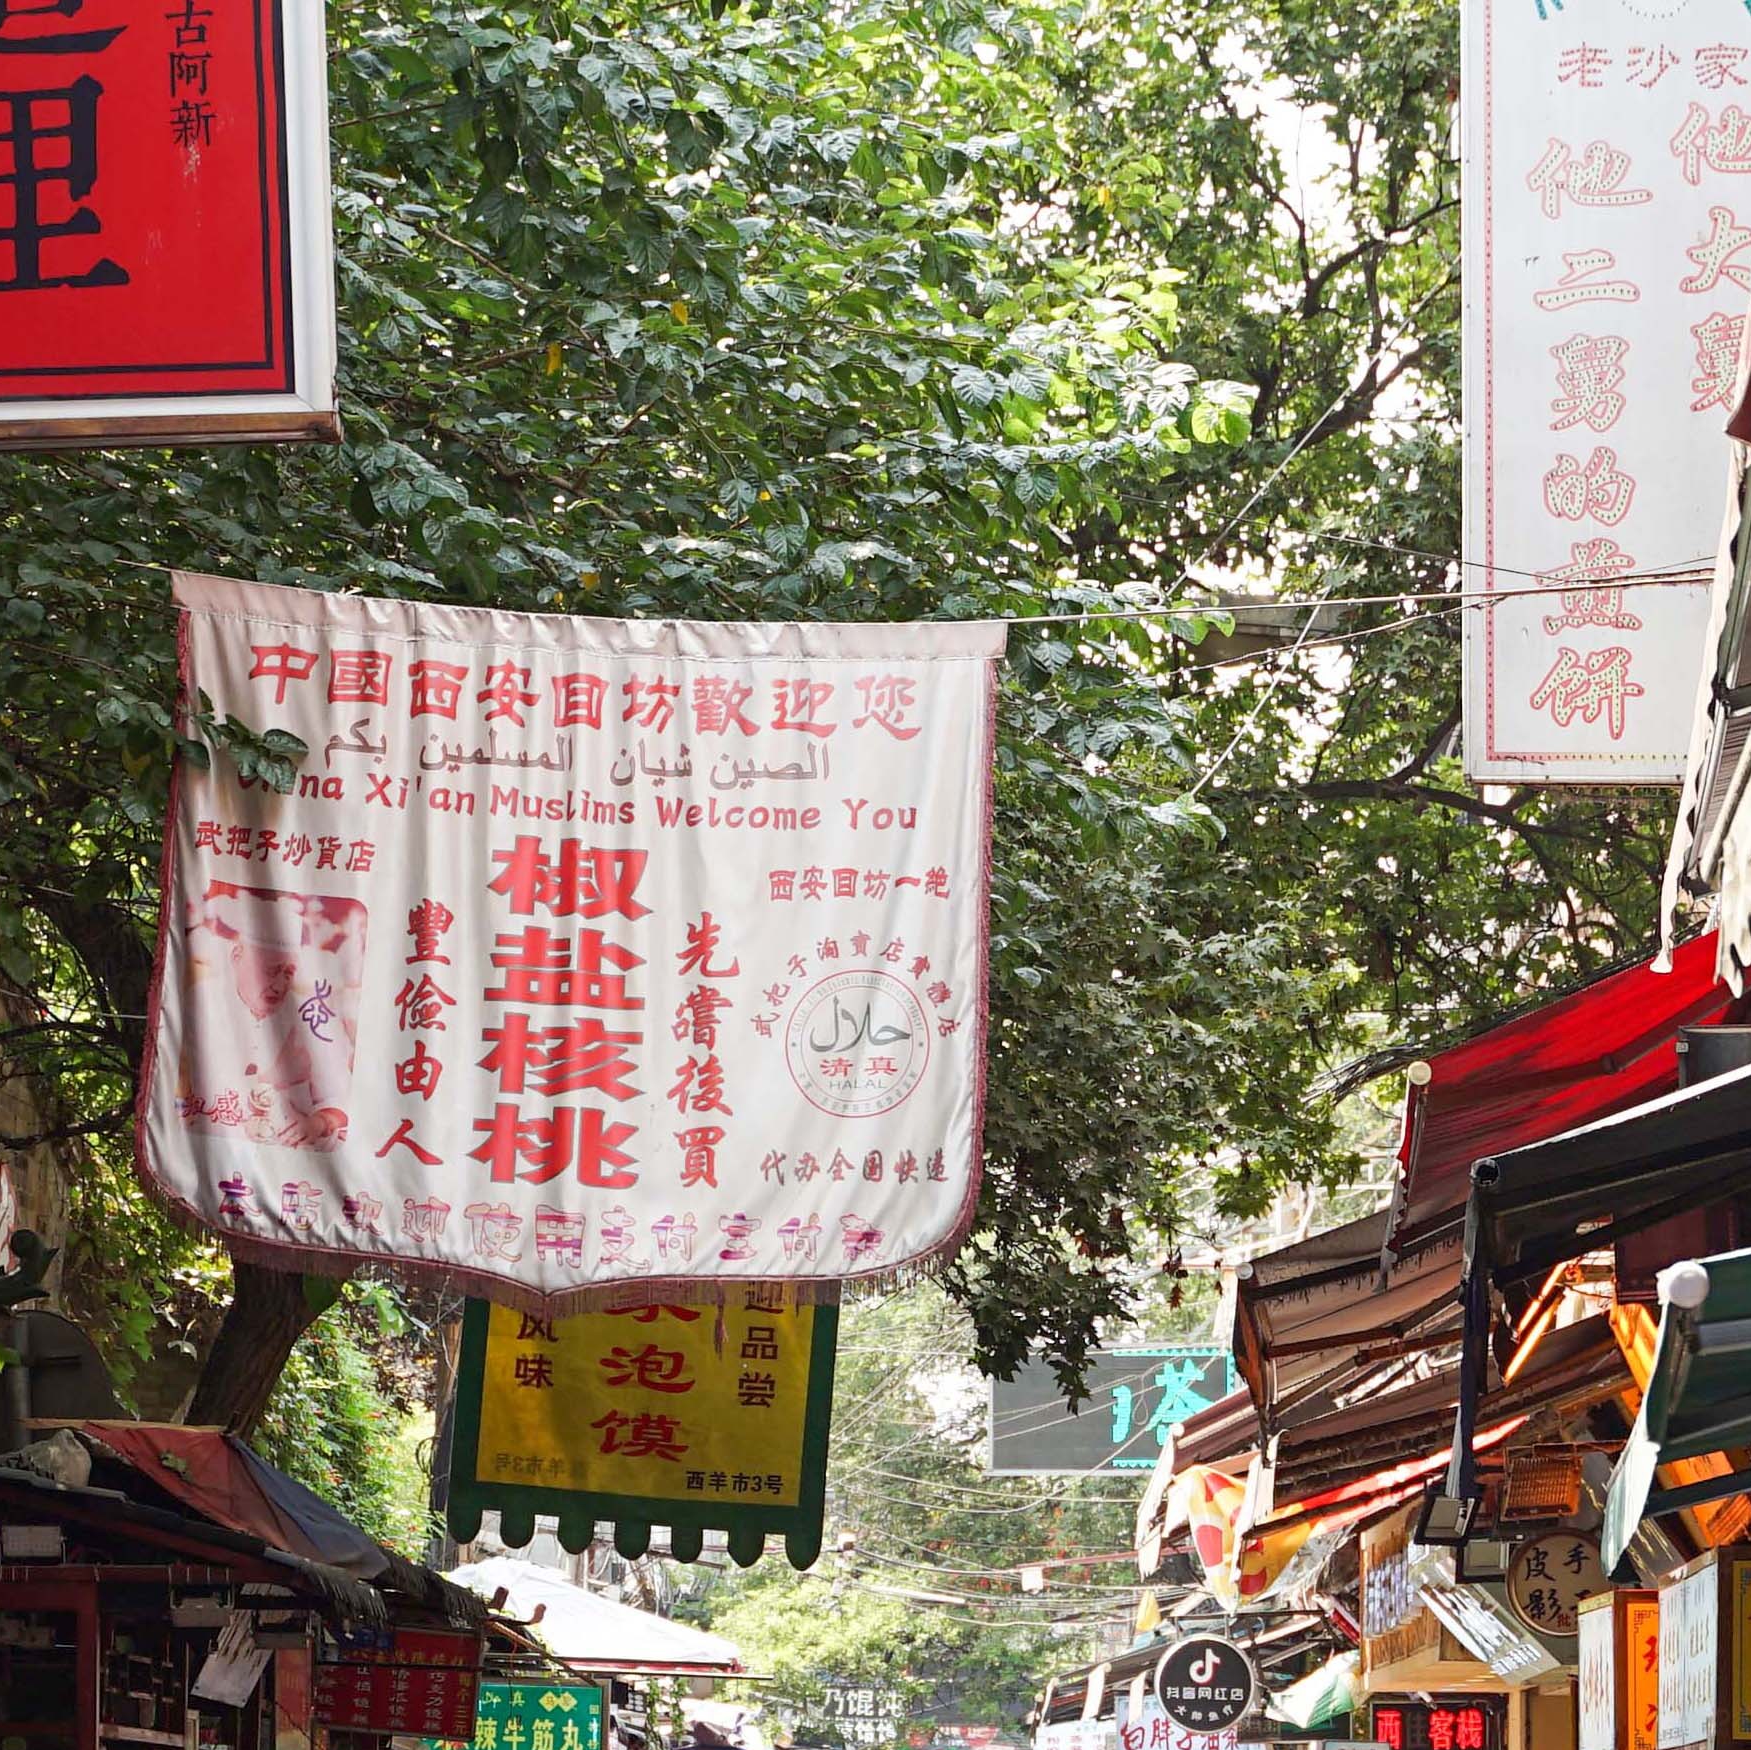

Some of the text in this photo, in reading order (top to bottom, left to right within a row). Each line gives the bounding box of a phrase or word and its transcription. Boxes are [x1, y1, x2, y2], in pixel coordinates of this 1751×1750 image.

[165, 2, 217, 147] 古阿新
[1558, 42, 1750, 89] 老沙家
[365, 772, 475, 816] Xi'an
[489, 784, 636, 826] Muslims
[655, 795, 822, 831] Welcome
[841, 798, 918, 831] You
[196, 821, 376, 873] 武把子炒貨店
[820, 1056, 899, 1079] 清真
[828, 1080, 888, 1091] HALAL
[685, 1470, 785, 1496] 西羊市3号
[1165, 1686, 1245, 1701] 抖音网红店
